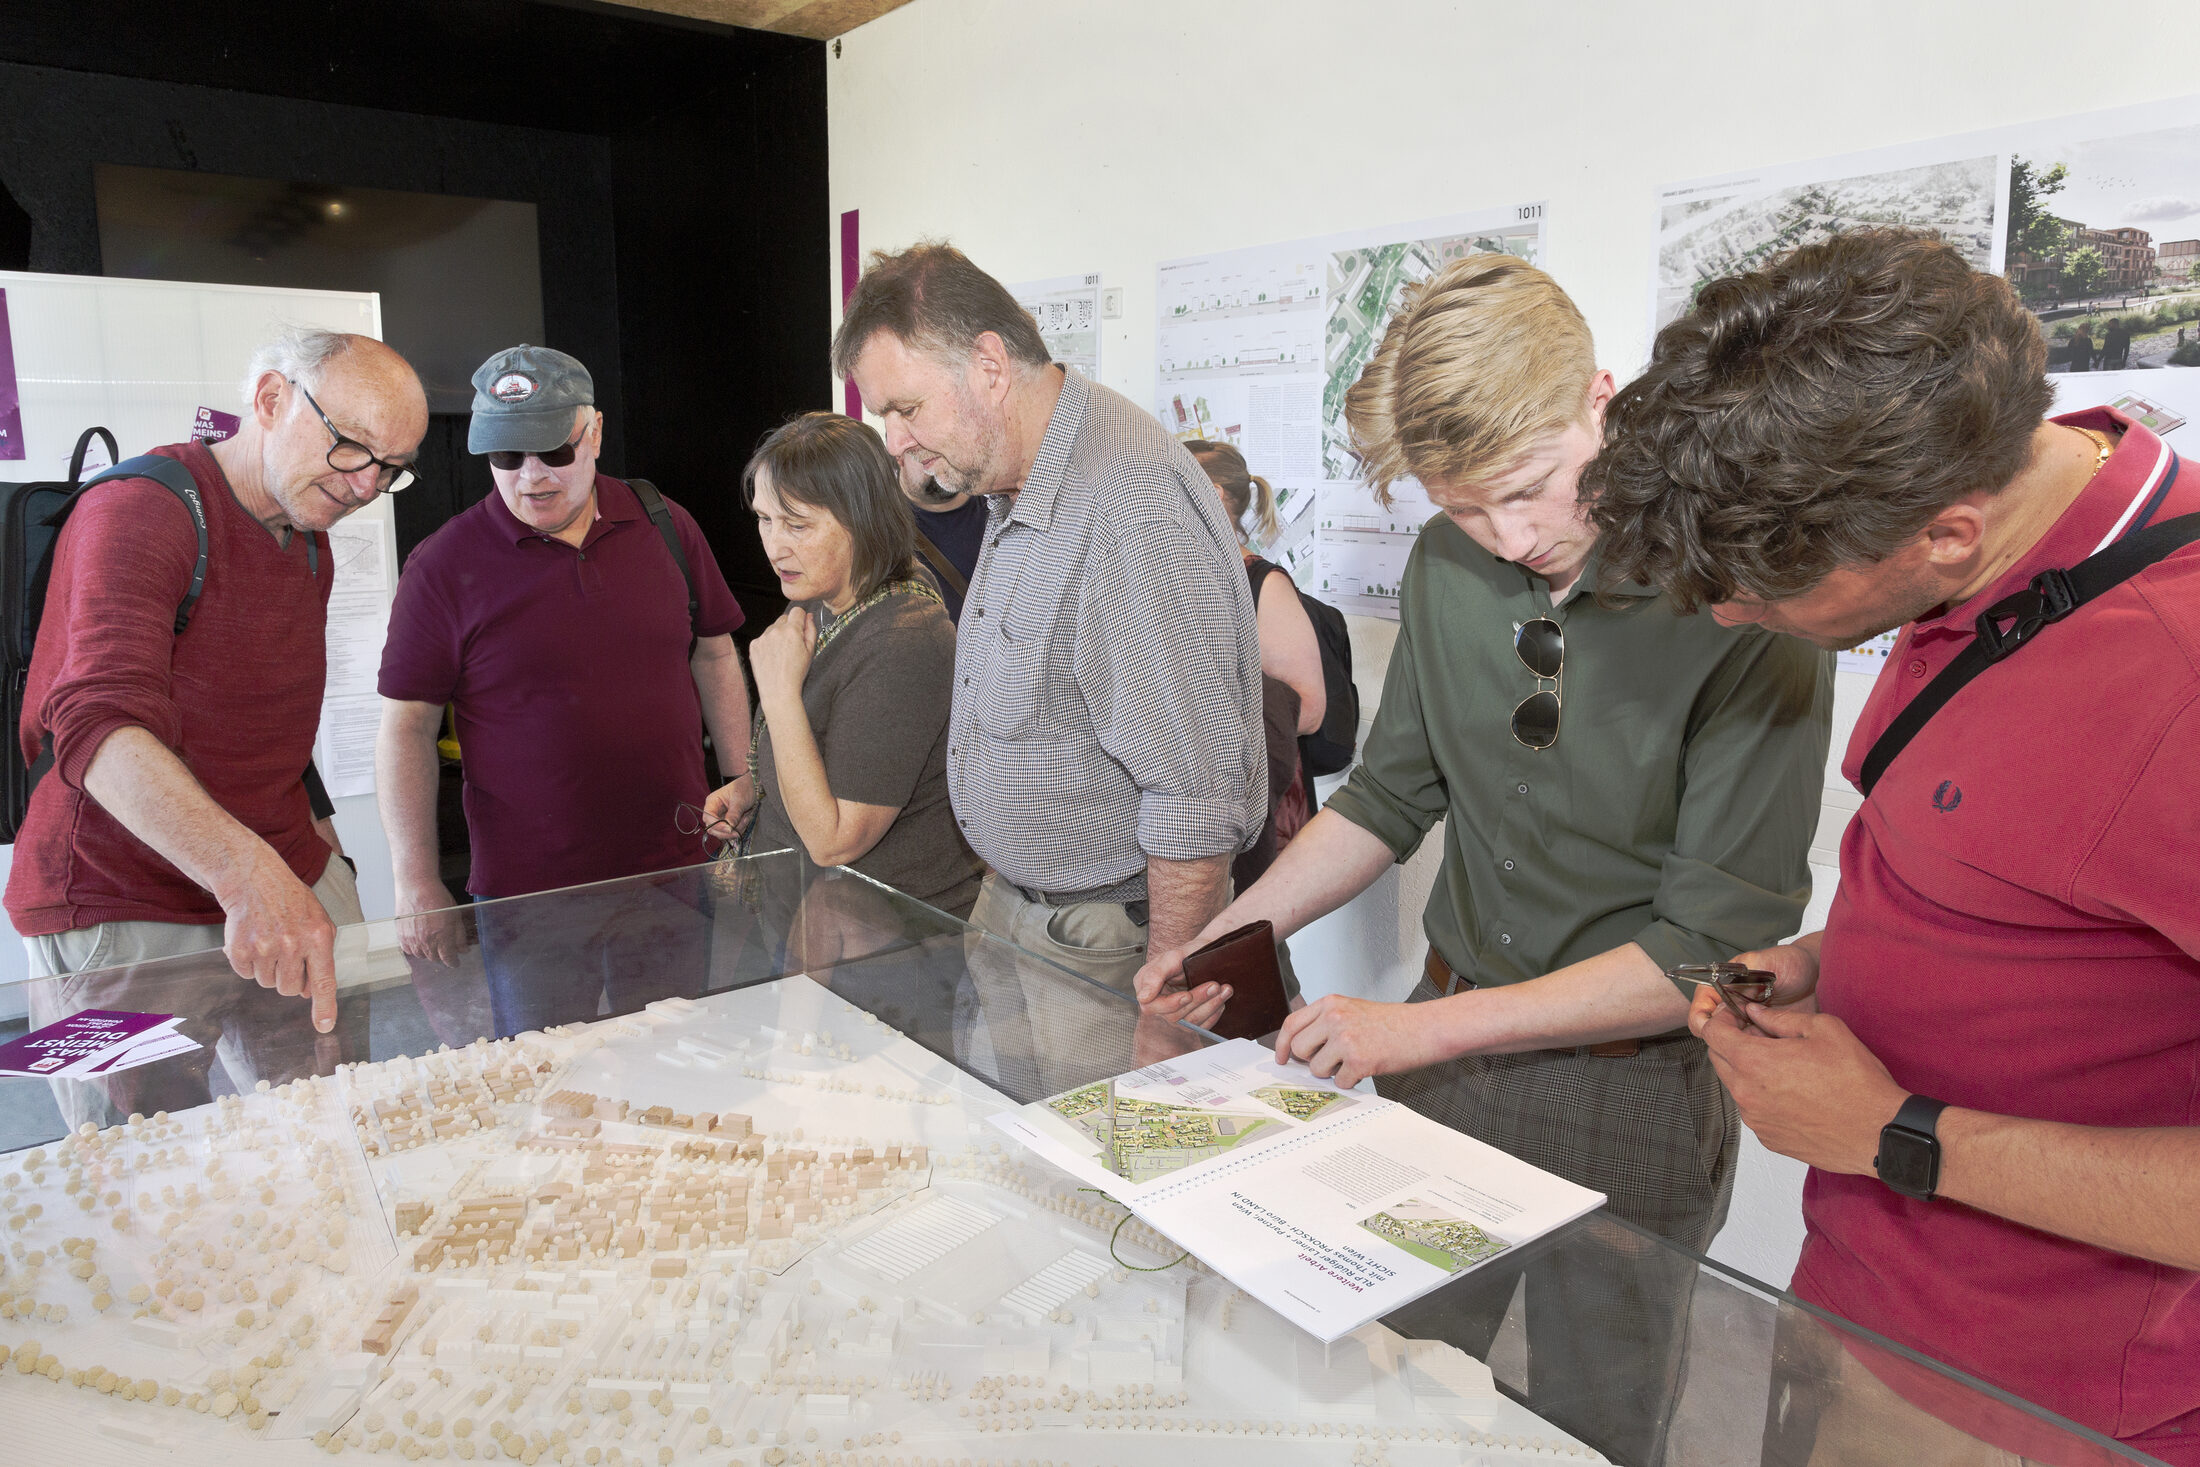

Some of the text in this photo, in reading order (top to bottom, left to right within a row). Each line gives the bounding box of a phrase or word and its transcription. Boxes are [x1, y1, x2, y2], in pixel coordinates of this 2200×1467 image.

[1518, 205, 1542, 220] 1011
[1085, 275, 1099, 285] 1011
[194, 421, 214, 429] WAS
[192, 429, 228, 439] MEINST
[65, 1031, 129, 1040] DU...?
[24, 1039, 113, 1049] MEINST
[41, 1048, 94, 1057] WAS
[1231, 1191, 1244, 1199] IN
[1232, 1202, 1252, 1217] Wien
[1242, 1198, 1265, 1213] LAND
[1252, 1214, 1286, 1236] Partner,
[1290, 1226, 1332, 1253] PROKSCH
[1291, 1238, 1320, 1258] Lainer
[1320, 1255, 1355, 1277] Rüdiger
[1333, 1251, 1367, 1272] Thomas
[1342, 1245, 1397, 1278] SICHT, Wien
[1298, 1253, 1364, 1293] Weitere Arbeit
[1368, 1272, 1386, 1282] mit
[1355, 1275, 1375, 1288] RLP
